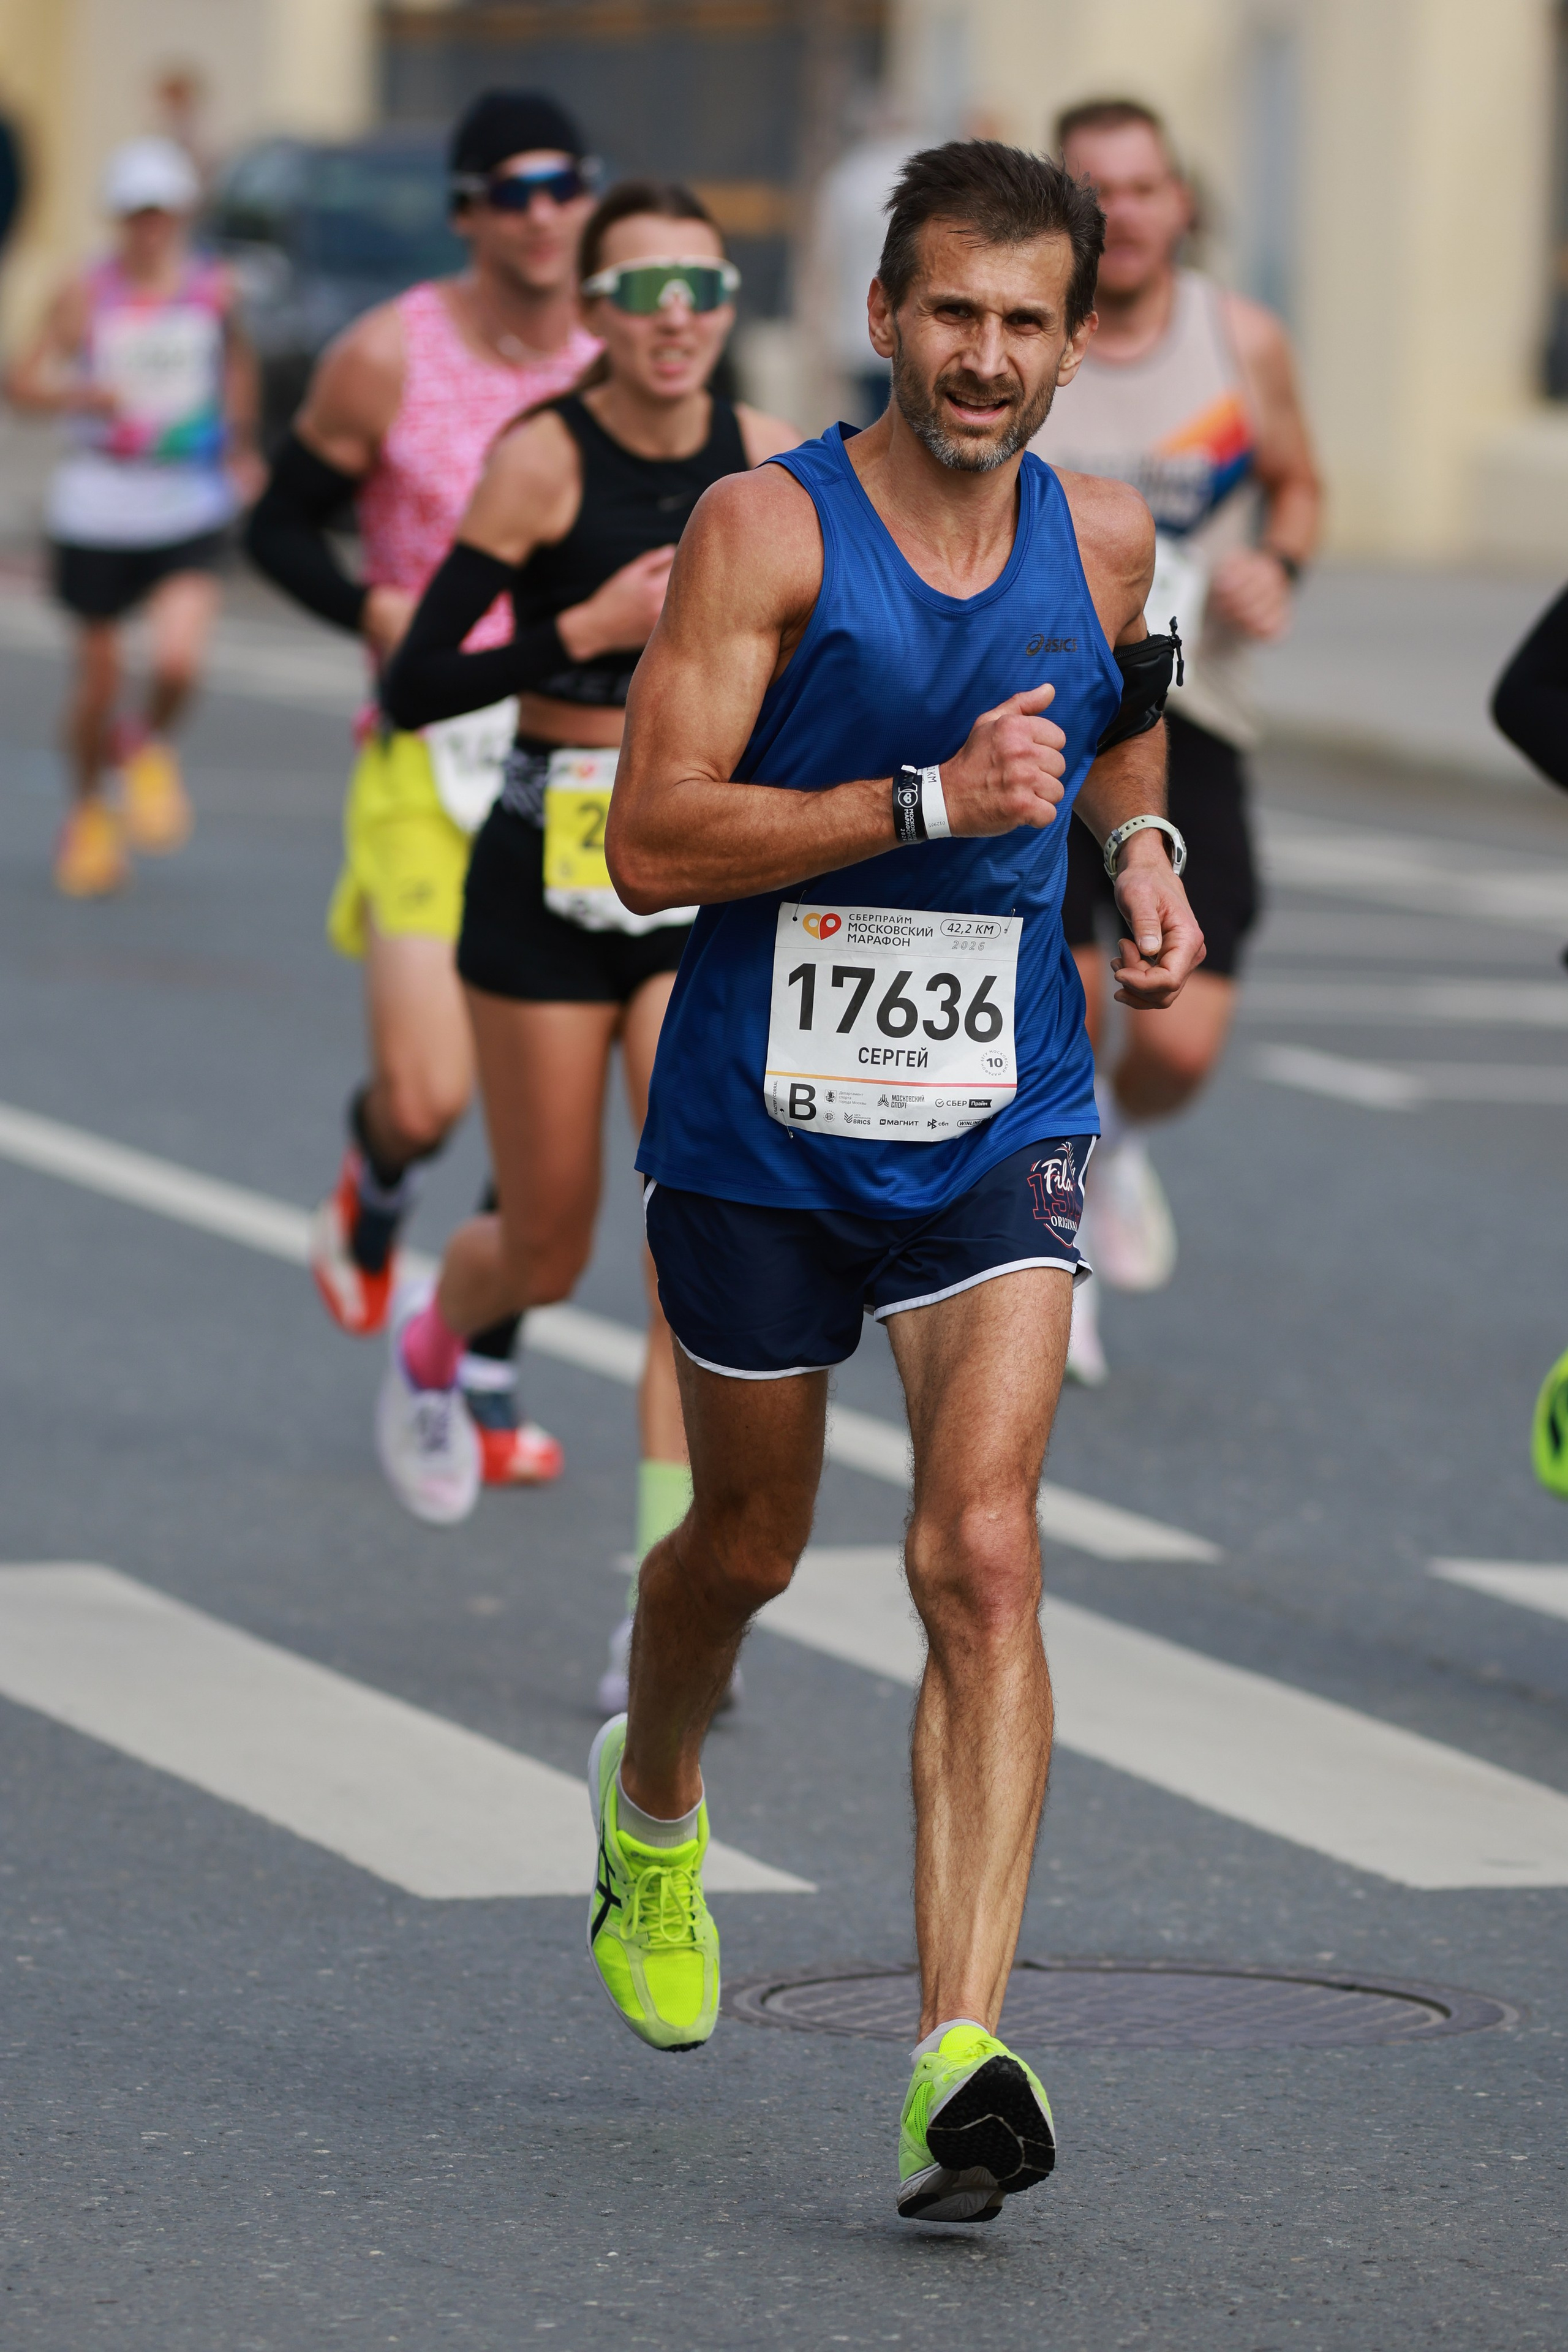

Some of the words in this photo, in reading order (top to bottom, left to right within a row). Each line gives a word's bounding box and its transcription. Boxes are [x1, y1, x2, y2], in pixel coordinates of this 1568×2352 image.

[849, 913, 912, 924] СБЕРПРАЙМ
[848, 922, 933, 937] МОСКОВСКИЙ
[947, 922, 972, 934] 42,2
[847, 933, 910, 947] МАРАФОН
[951, 940, 986, 951] 2026
[788, 963, 1003, 1043] 17636
[858, 1047, 929, 1068] СЕРГЕЙ
[986, 1058, 1003, 1068] 10
